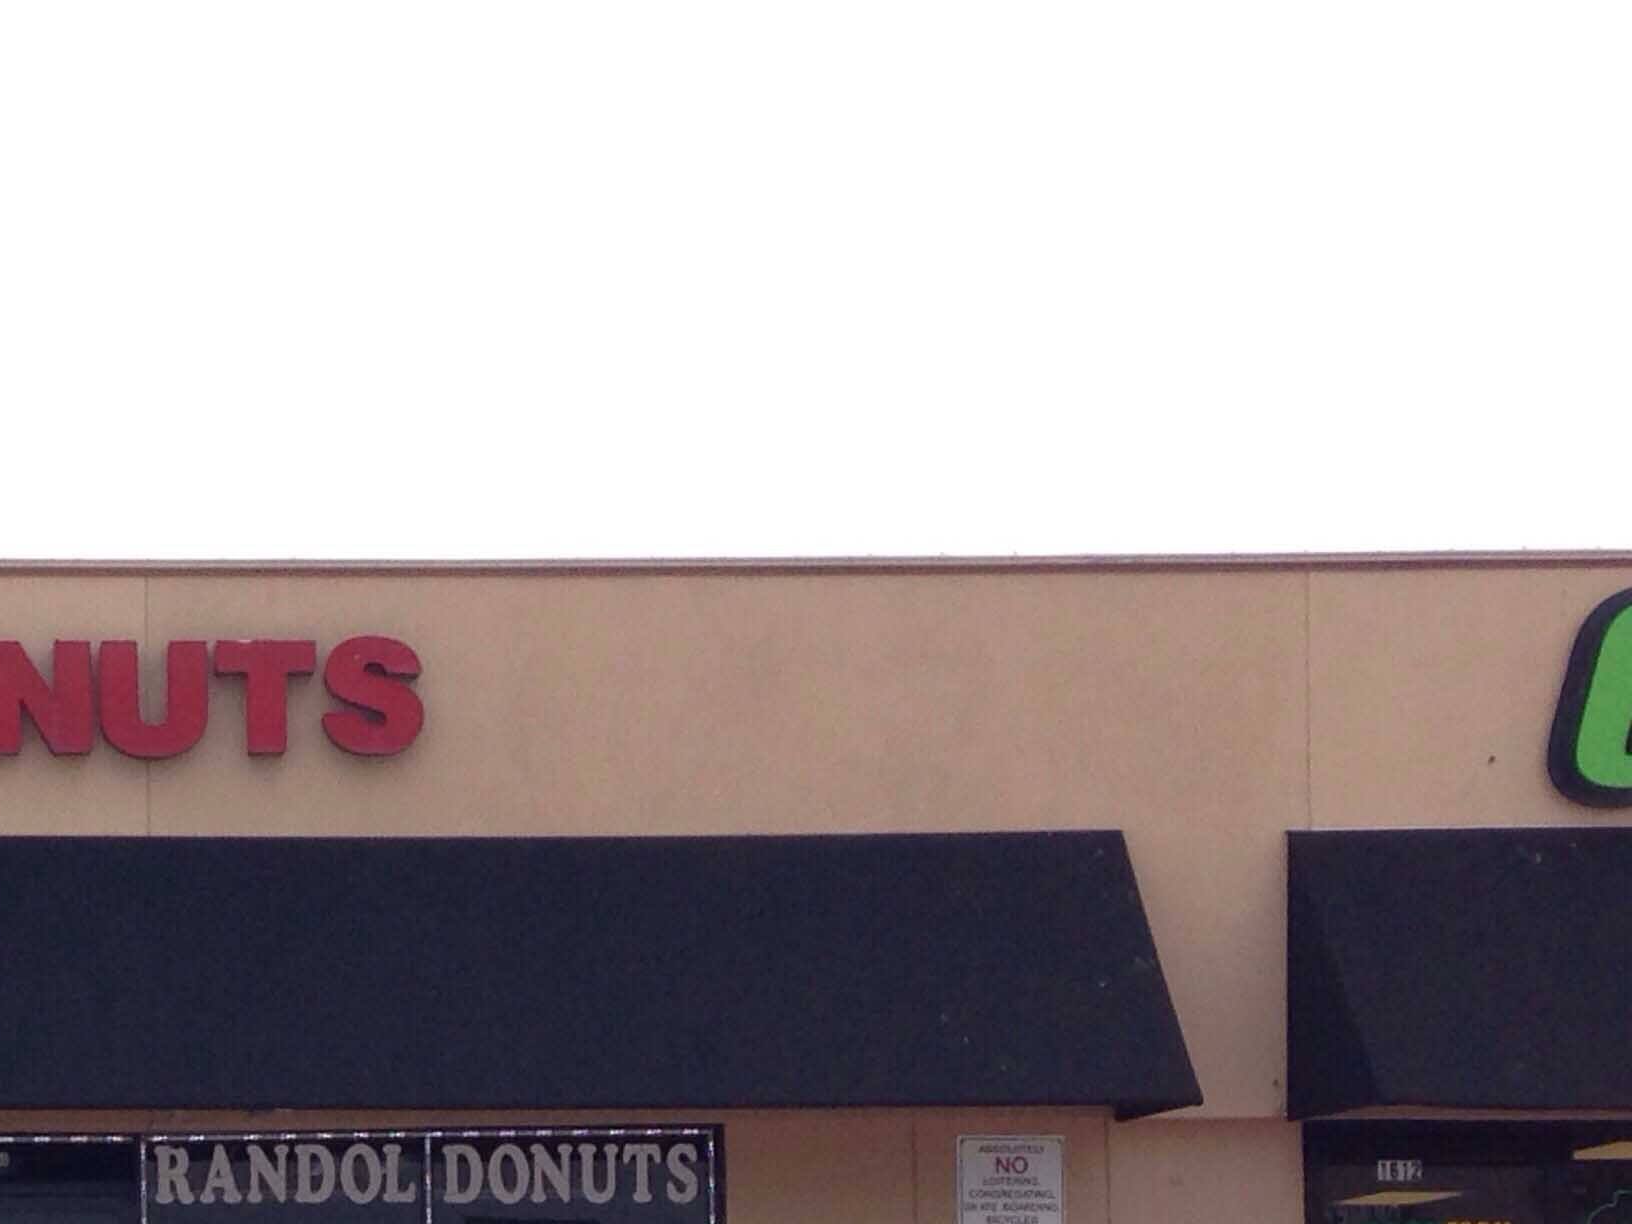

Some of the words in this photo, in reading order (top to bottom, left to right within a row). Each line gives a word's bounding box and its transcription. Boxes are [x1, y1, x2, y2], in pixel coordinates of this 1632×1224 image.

[154, 1143, 416, 1204] RANDOL
[442, 1142, 699, 1204] DONUTS
[995, 1156, 1029, 1174] NO
